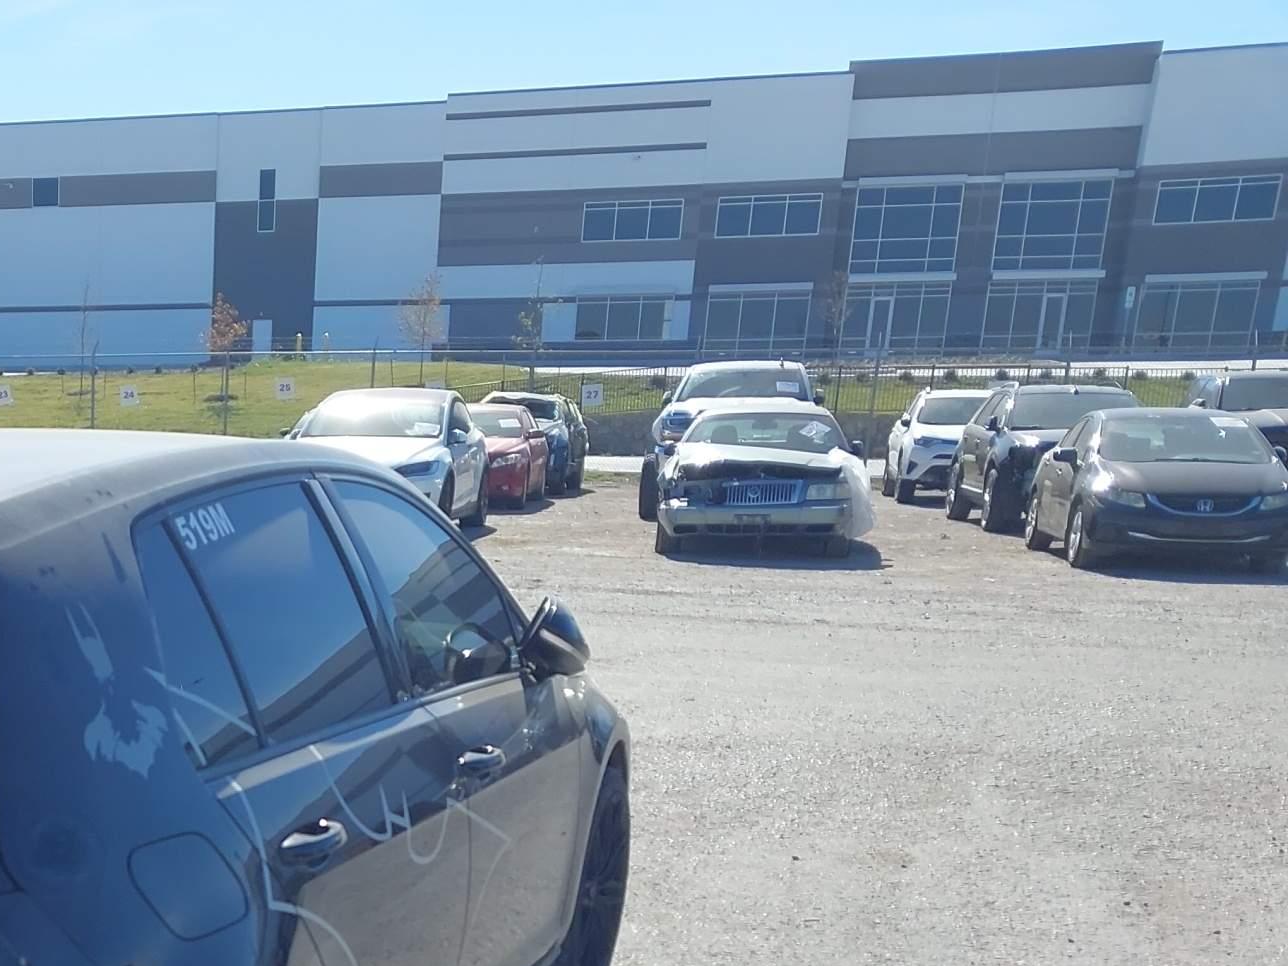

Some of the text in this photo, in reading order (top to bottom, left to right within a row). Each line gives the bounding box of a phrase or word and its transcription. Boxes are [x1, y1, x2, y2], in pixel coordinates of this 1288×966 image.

[279, 383, 291, 391] 25
[123, 390, 134, 399] 24
[586, 390, 599, 399] 27
[174, 502, 235, 549] 519M
